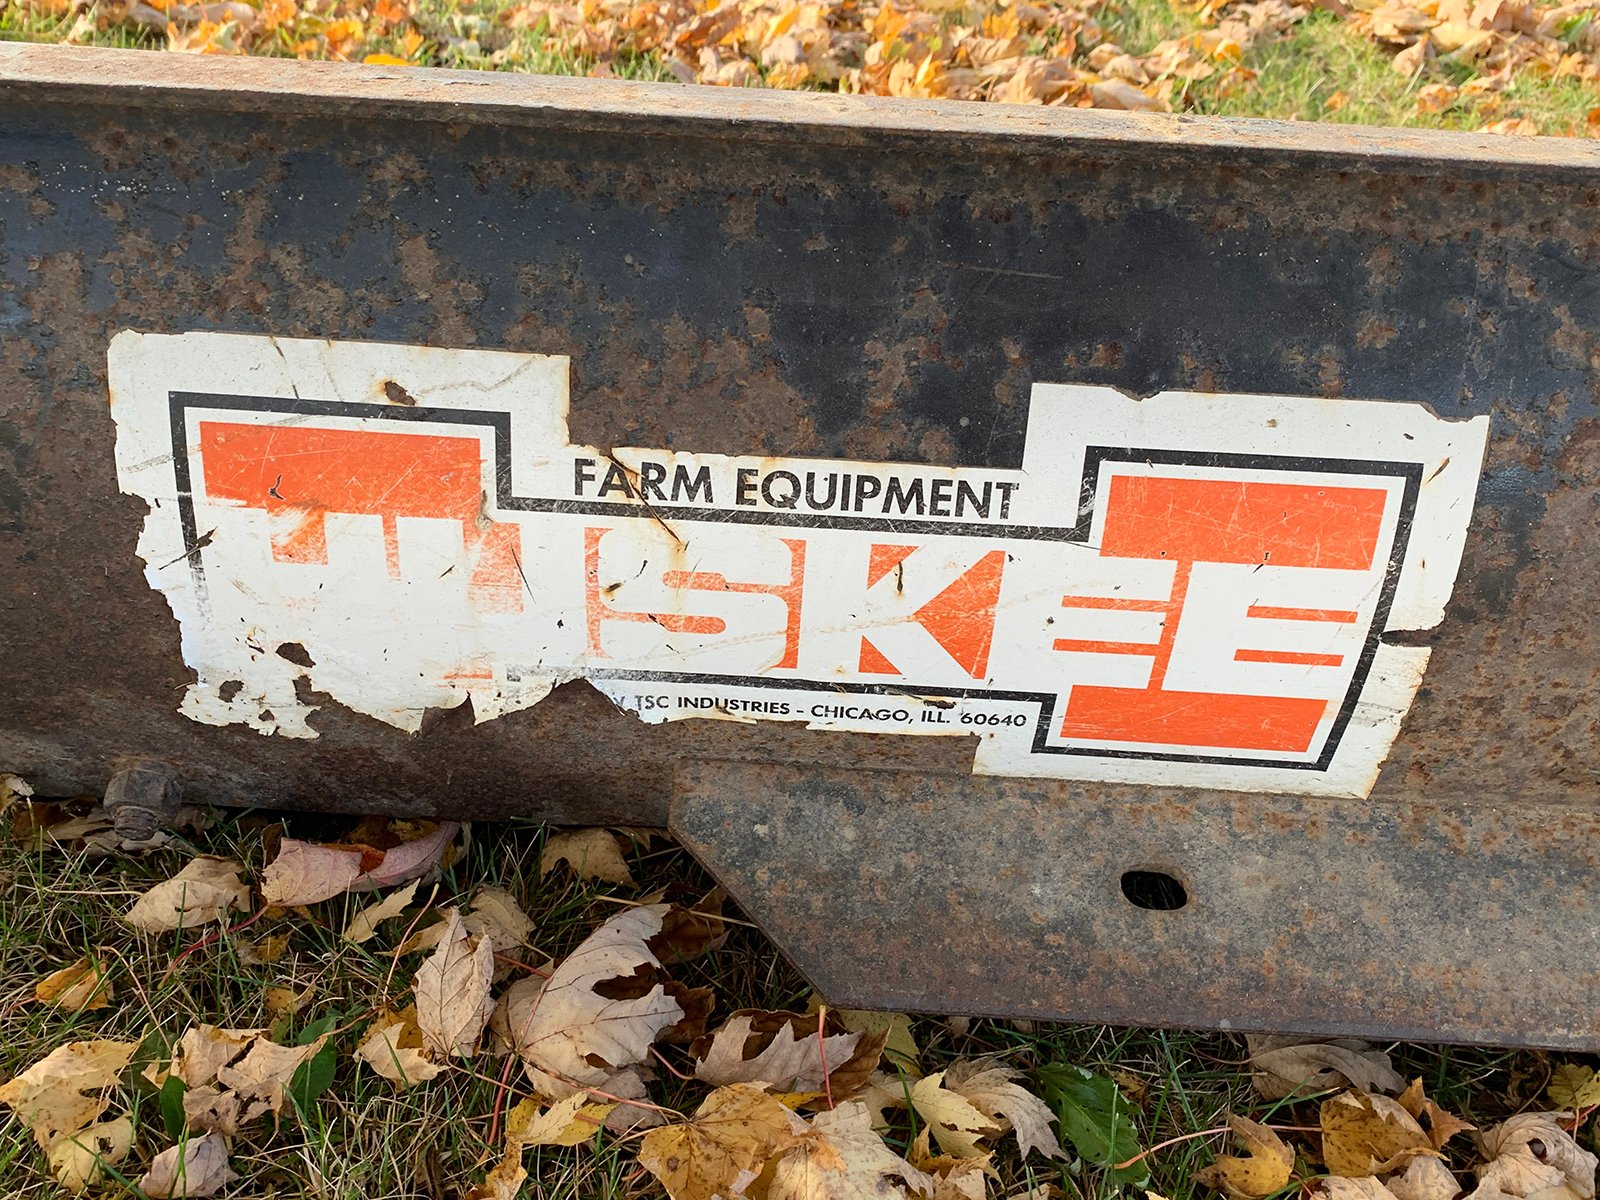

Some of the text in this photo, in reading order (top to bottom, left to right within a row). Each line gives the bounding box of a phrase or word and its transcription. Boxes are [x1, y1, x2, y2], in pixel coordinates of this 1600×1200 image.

[573, 457, 1020, 521] FARM EQUIPMENT
[634, 695, 669, 711] TSC
[677, 696, 790, 715] INDUSTRIES
[810, 704, 914, 724] CHICAGO,
[921, 710, 950, 723] ILL.
[960, 713, 1027, 727] 60640
